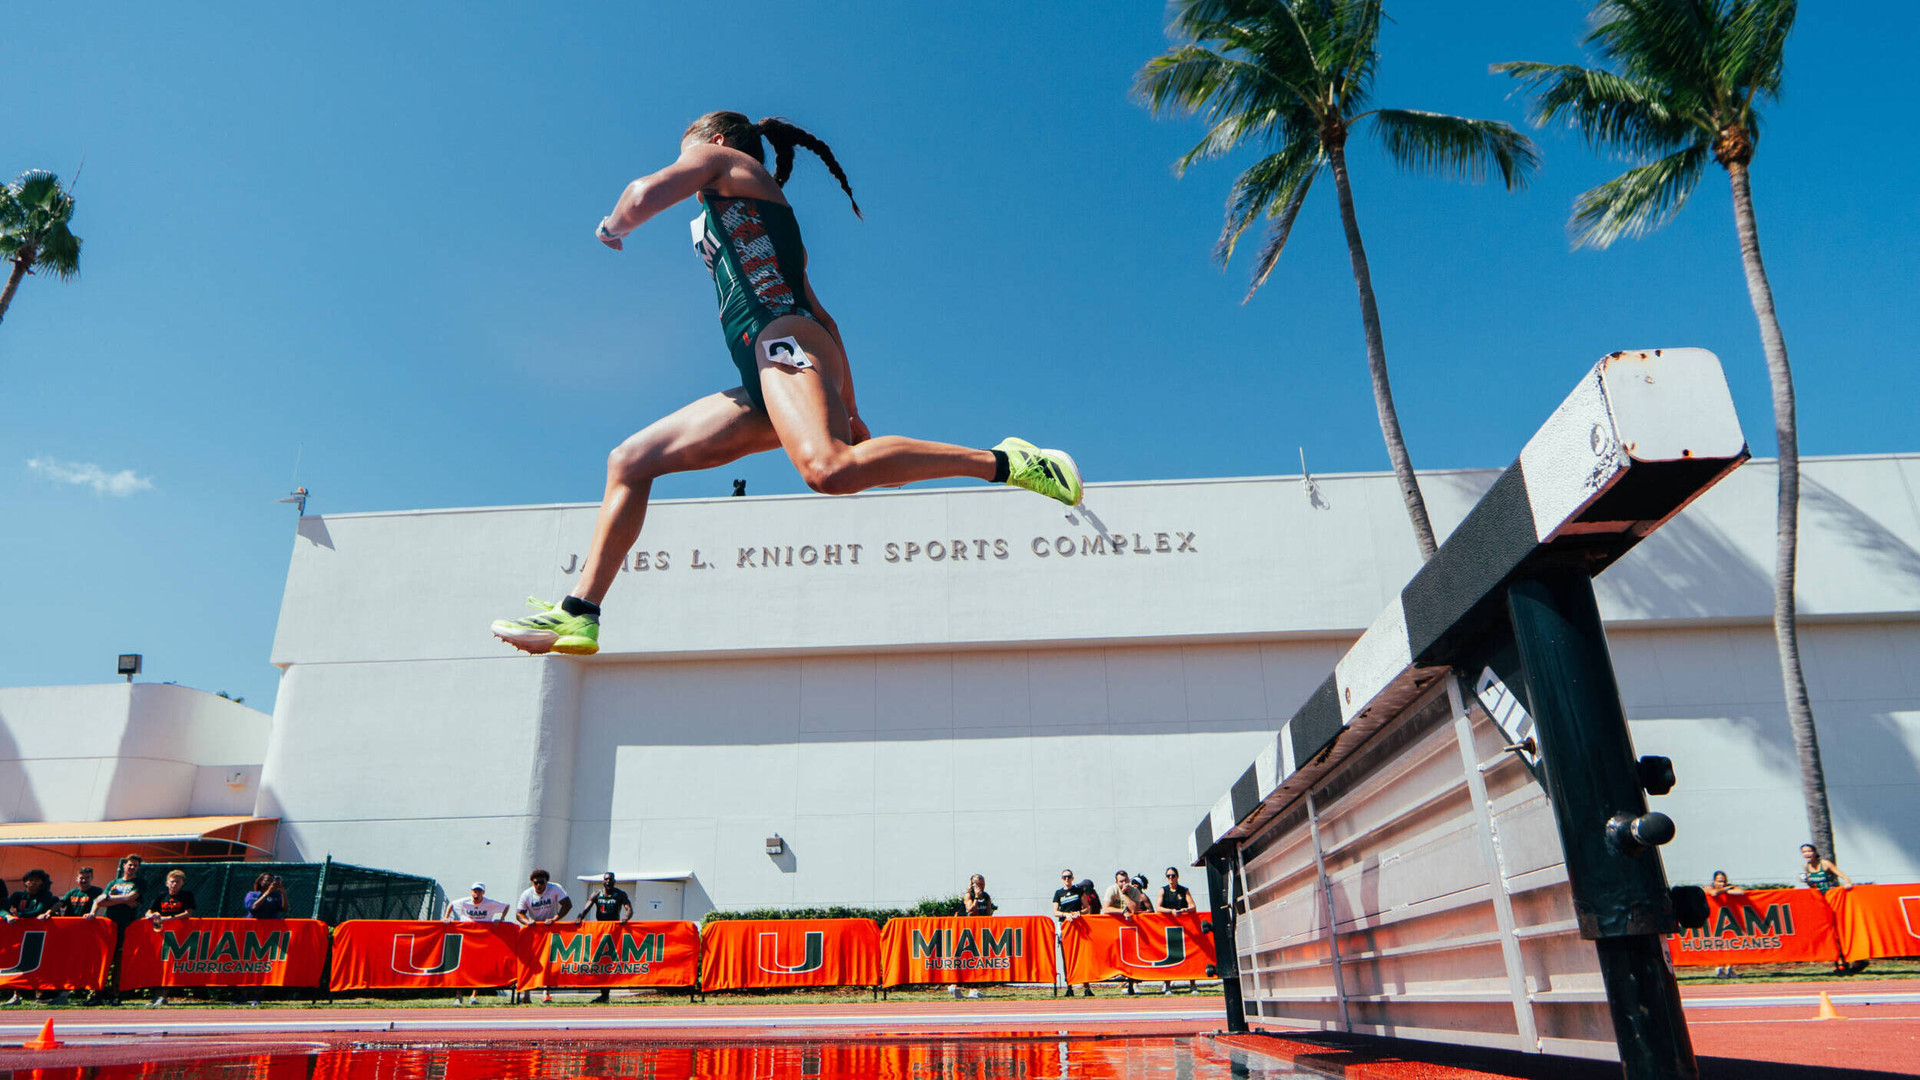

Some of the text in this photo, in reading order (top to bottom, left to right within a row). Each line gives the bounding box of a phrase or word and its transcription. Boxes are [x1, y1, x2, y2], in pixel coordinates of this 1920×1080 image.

[560, 531, 1199, 575] JES L. KNIGHT SPORTS COMPLEX
[161, 930, 291, 962] MIAMI
[391, 932, 464, 976] U
[549, 932, 665, 963] MIAMI
[758, 931, 825, 974] U
[911, 927, 1023, 959] MIAMI
[1119, 926, 1186, 968] U
[1682, 936, 1782, 952] HURRICANES
[172, 959, 273, 974] HURRICANES
[560, 961, 650, 975] HURRICANES
[924, 957, 1011, 970] HURRICANES
